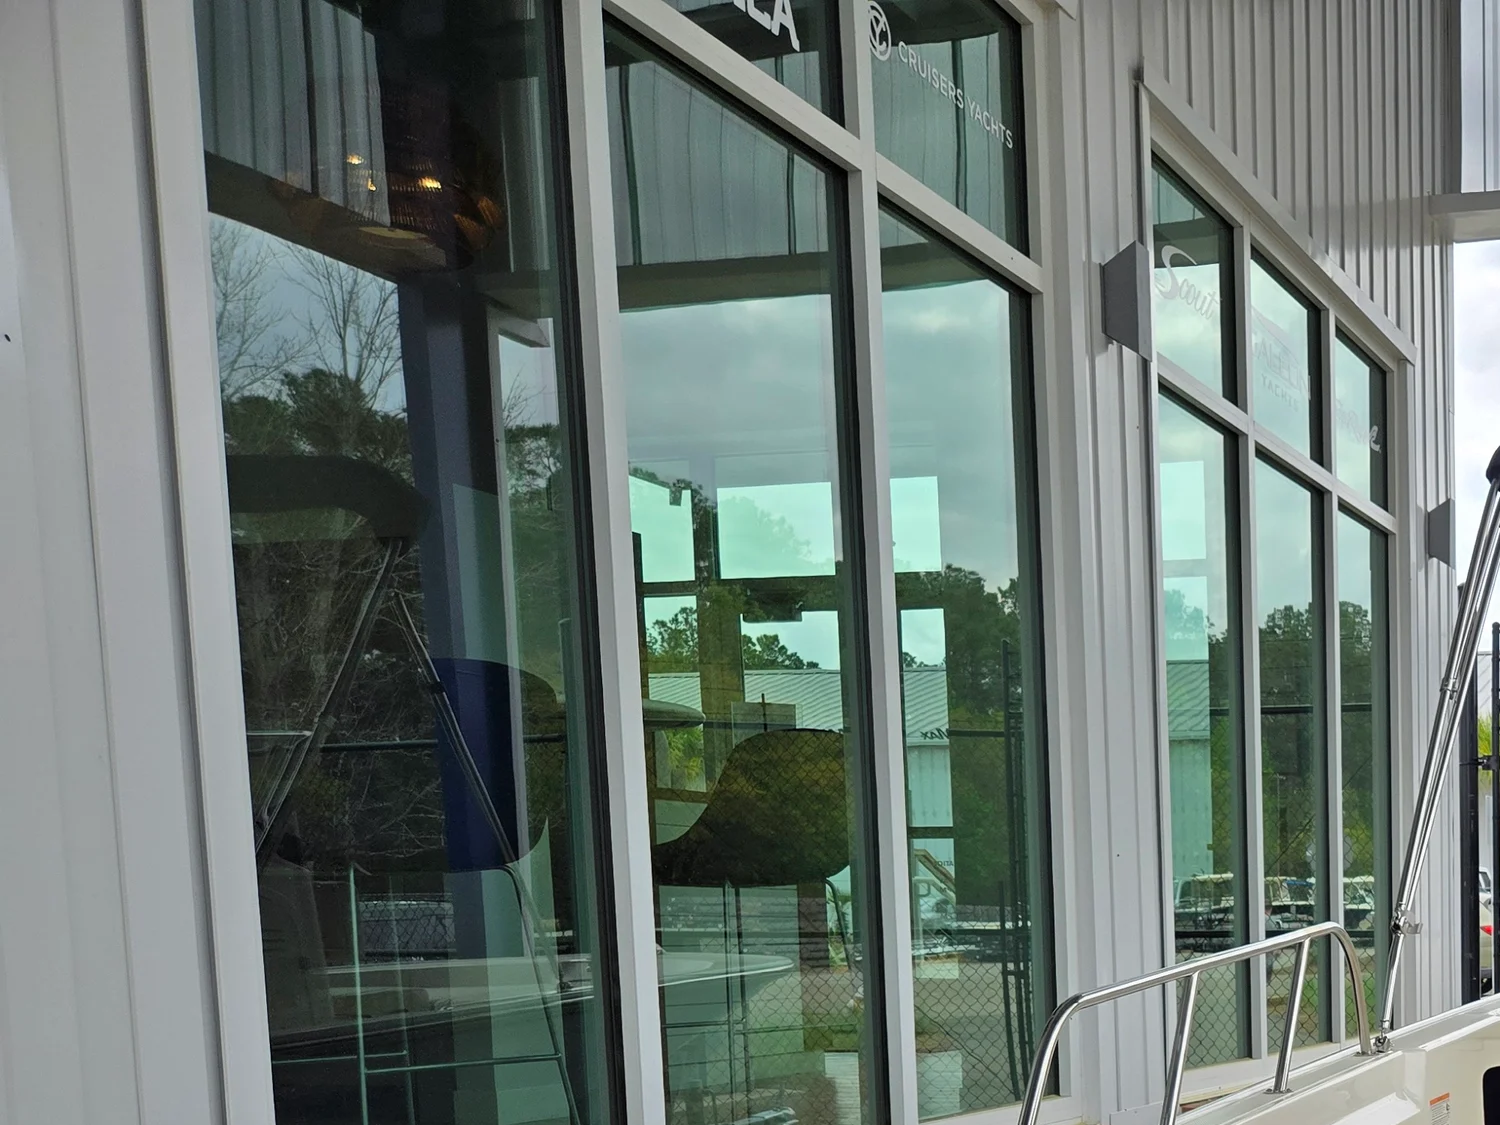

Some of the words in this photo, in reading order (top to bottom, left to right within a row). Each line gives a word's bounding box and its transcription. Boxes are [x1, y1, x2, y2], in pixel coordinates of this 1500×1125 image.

[899, 41, 964, 109] CRUISERS
[966, 96, 1013, 149] YACHTS
[1155, 244, 1219, 320] Scout
